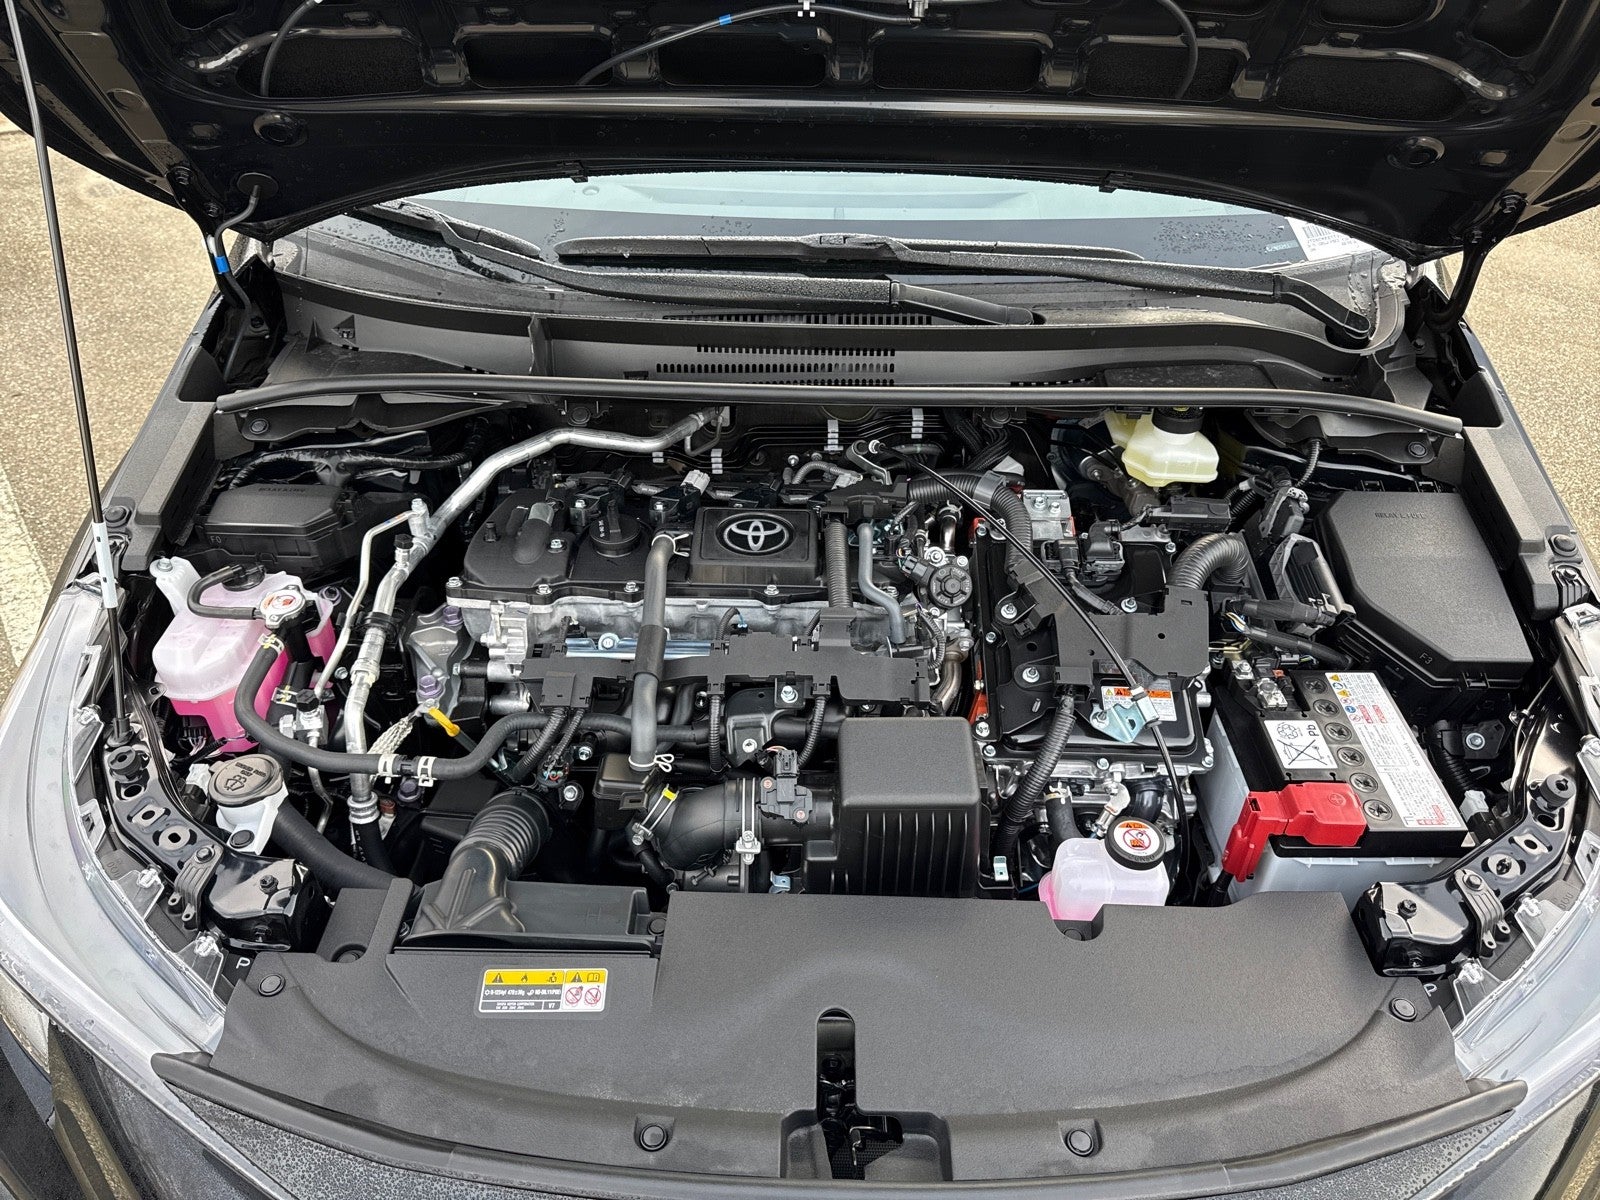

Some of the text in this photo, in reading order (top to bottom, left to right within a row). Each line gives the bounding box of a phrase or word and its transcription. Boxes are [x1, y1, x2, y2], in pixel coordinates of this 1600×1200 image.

[1419, 652, 1433, 665] F3
[1306, 724, 1319, 737] Pb
[235, 957, 251, 969] P
[1423, 983, 1438, 997] P
